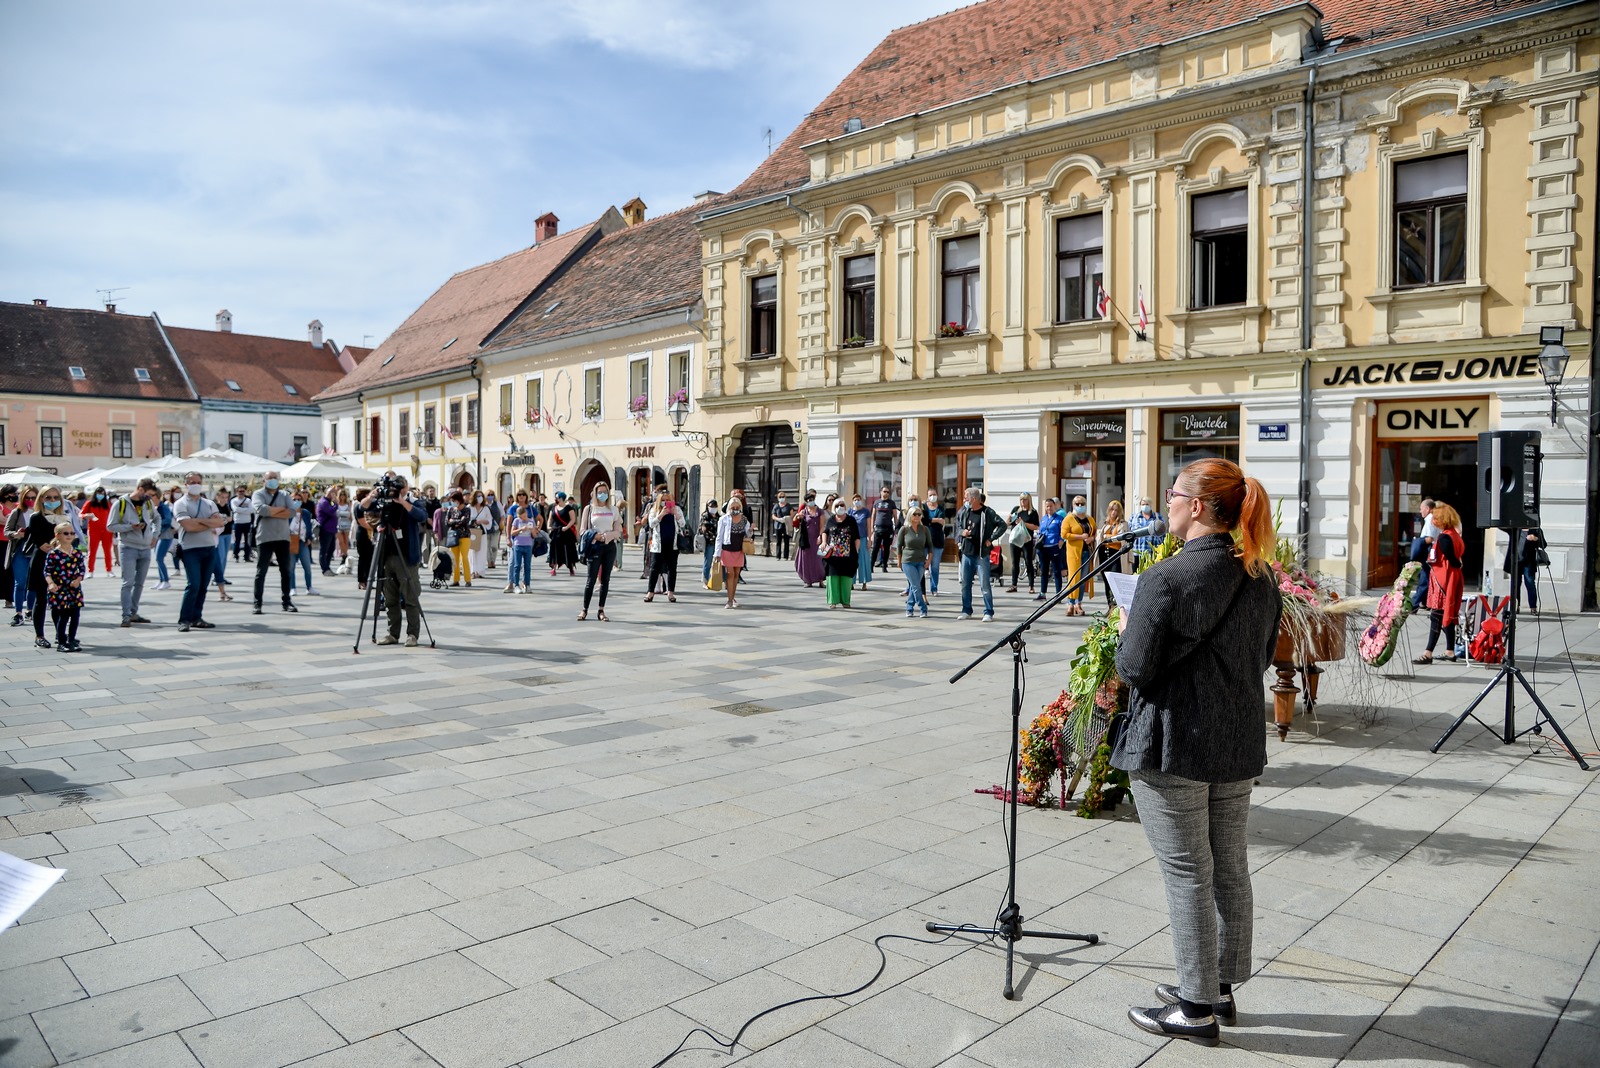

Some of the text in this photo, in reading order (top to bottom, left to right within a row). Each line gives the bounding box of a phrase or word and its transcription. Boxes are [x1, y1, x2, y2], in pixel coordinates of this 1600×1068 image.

[1323, 354, 1543, 386] JACK JONE
[1072, 417, 1123, 434] Suvenirnica
[1179, 414, 1228, 430] Vinoteka
[1387, 407, 1480, 430] ONLY
[626, 446, 656, 459] TISAK
